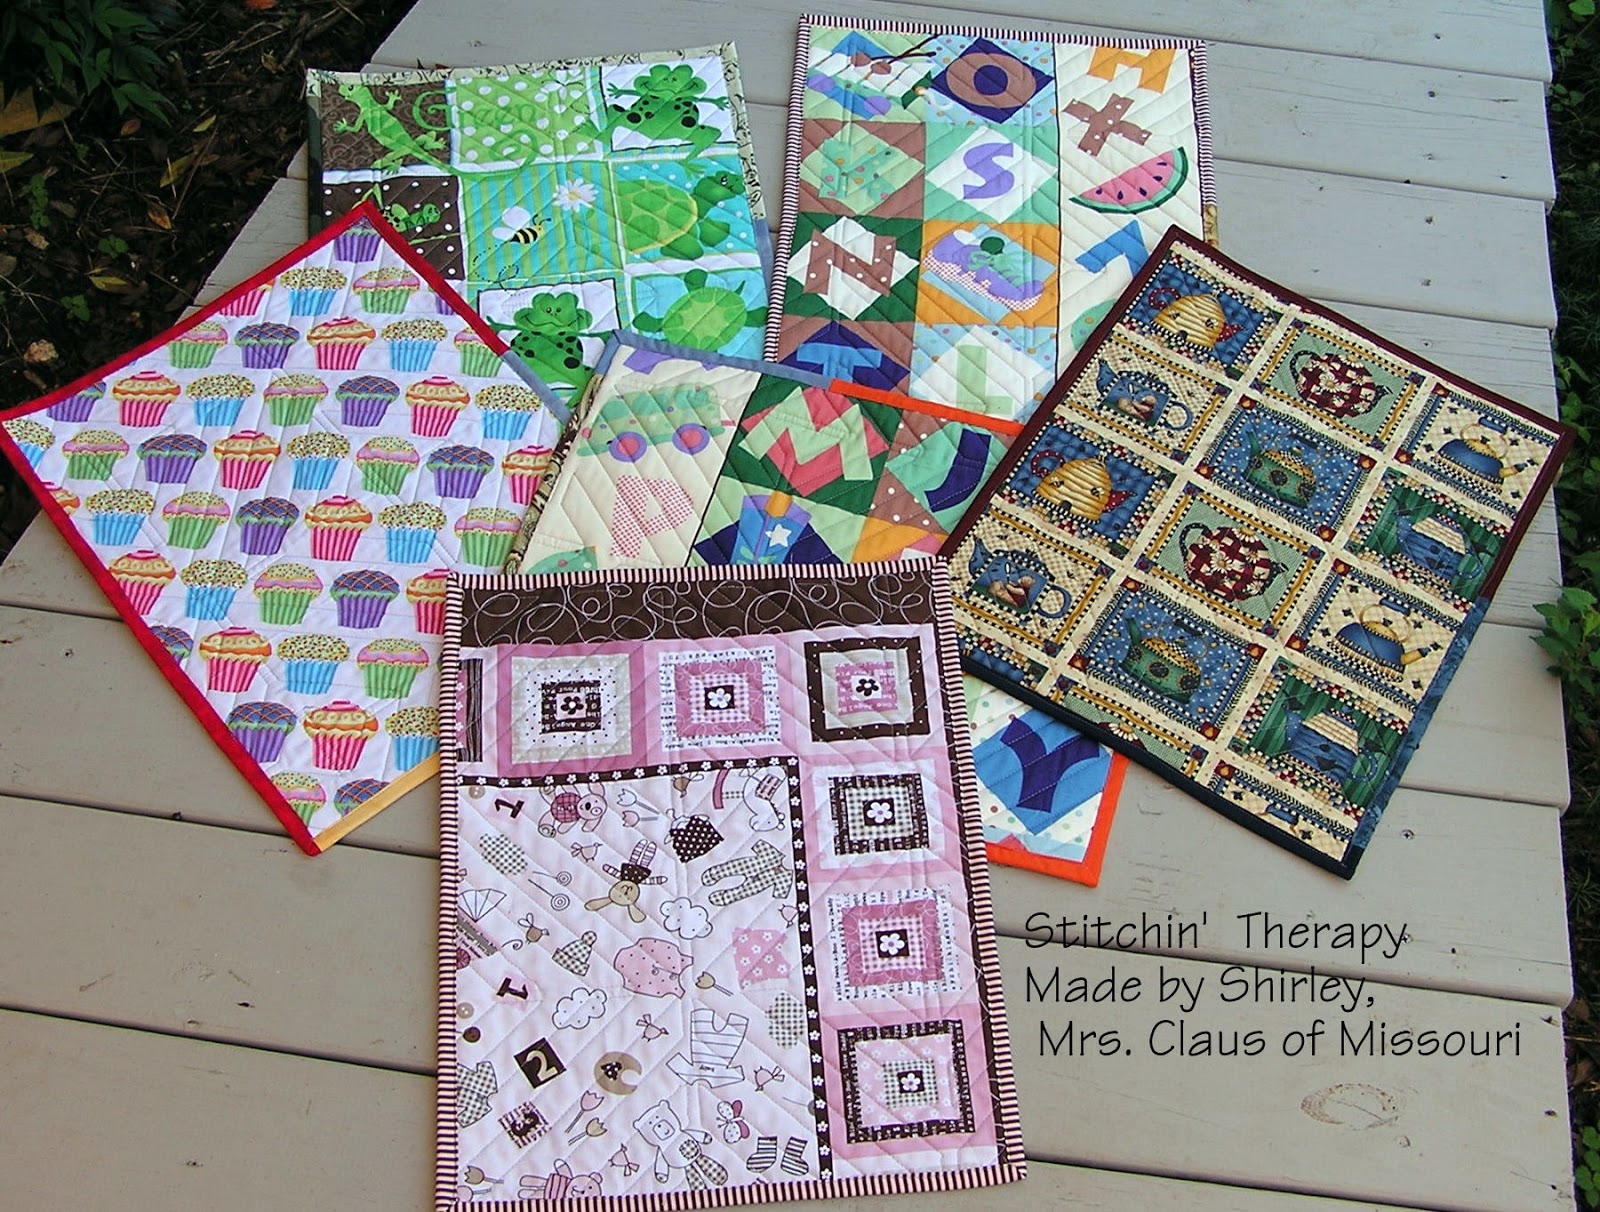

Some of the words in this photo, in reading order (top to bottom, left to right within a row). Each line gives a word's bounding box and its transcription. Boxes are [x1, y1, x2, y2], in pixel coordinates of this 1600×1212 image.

[412, 86, 538, 131] Green
[961, 142, 1015, 200] S
[803, 228, 898, 297] N
[797, 343, 883, 384] T
[956, 345, 1014, 416] L
[738, 403, 874, 481] M
[923, 428, 991, 512] J
[610, 474, 694, 558] P
[1000, 717, 1100, 814] Y
[525, 1050, 558, 1081] 2
